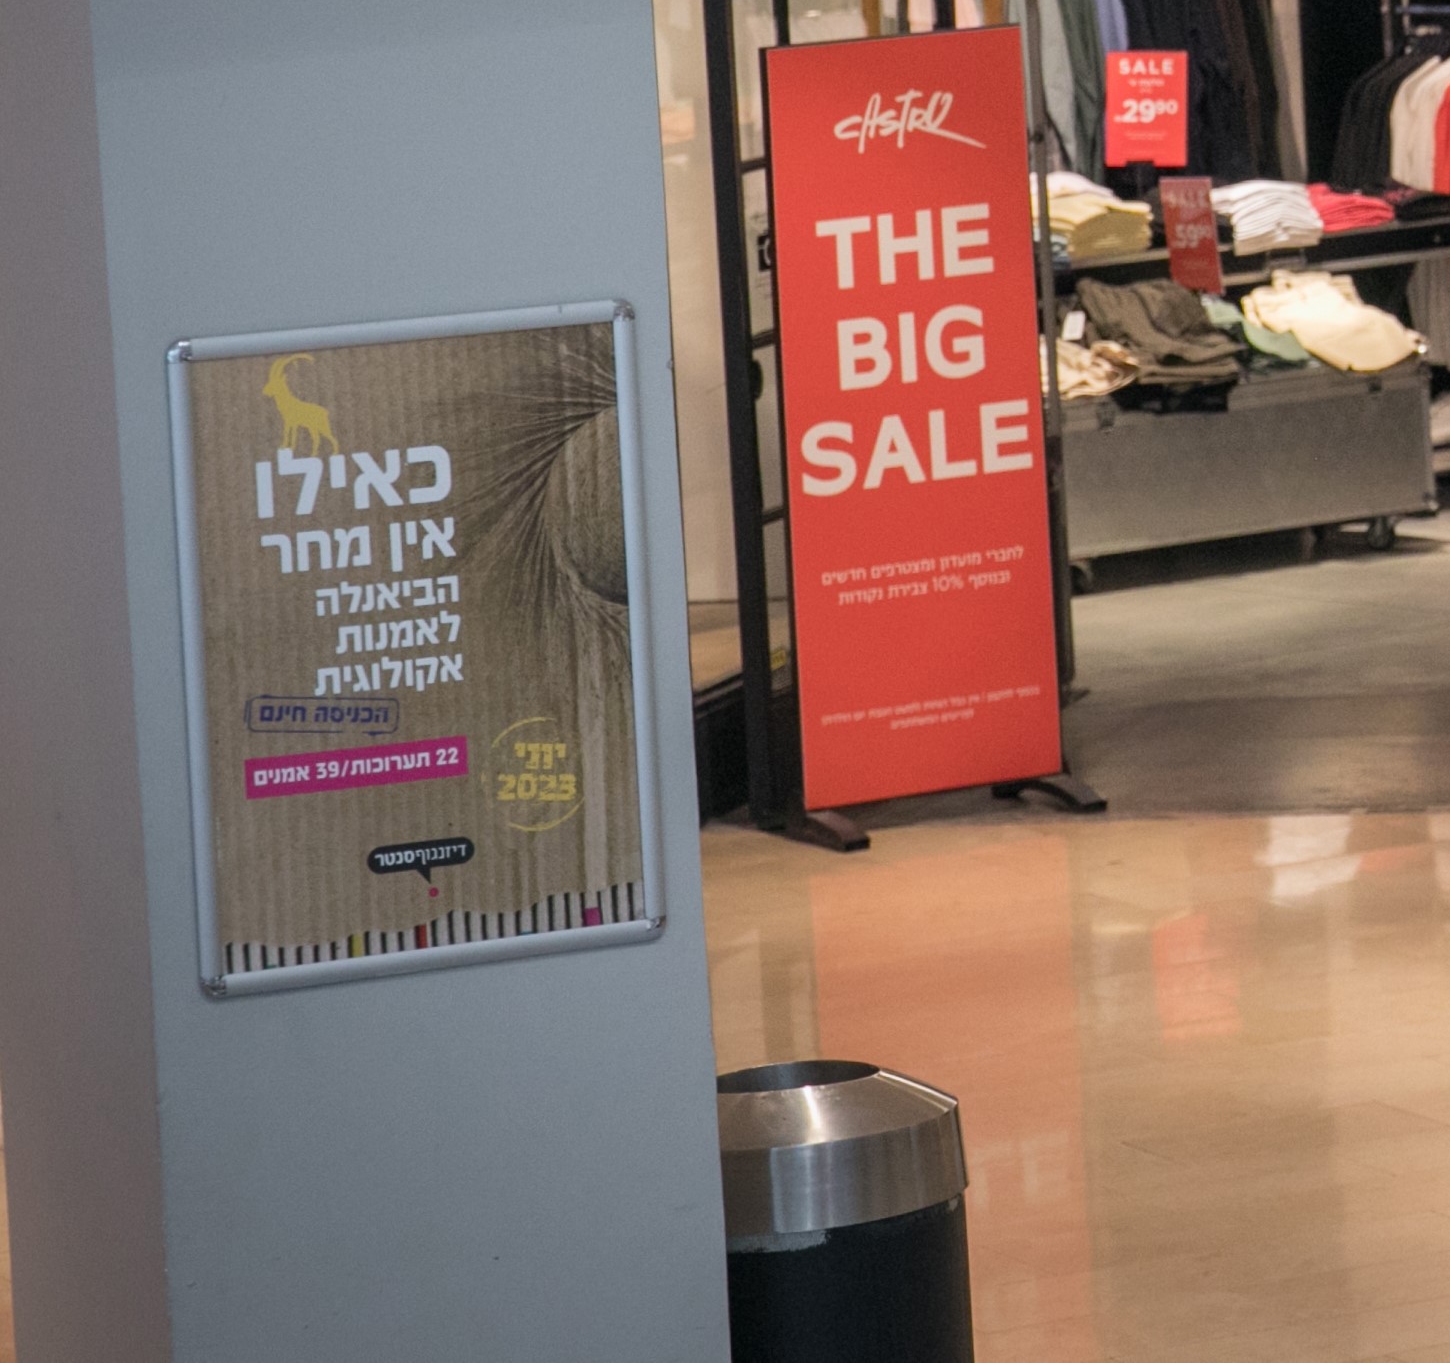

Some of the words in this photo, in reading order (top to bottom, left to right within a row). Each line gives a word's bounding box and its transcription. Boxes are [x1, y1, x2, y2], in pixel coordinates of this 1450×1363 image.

[1118, 58, 1175, 76] SALE
[815, 202, 995, 290] THE
[836, 305, 986, 392] BIG
[801, 399, 1034, 498] SALE
[255, 445, 452, 519] כאילו
[260, 525, 372, 573] מחר
[389, 517, 457, 572] אין
[315, 575, 460, 617] הביאנלה
[335, 610, 461, 655] לאמנות
[314, 653, 464, 697] אקולוגית
[259, 704, 307, 723] חינם
[314, 705, 390, 724] הכניסה
[253, 765, 310, 787] אמנים
[436, 747, 459, 765] 22
[513, 742, 567, 770] יוני
[497, 773, 577, 801] 2023
